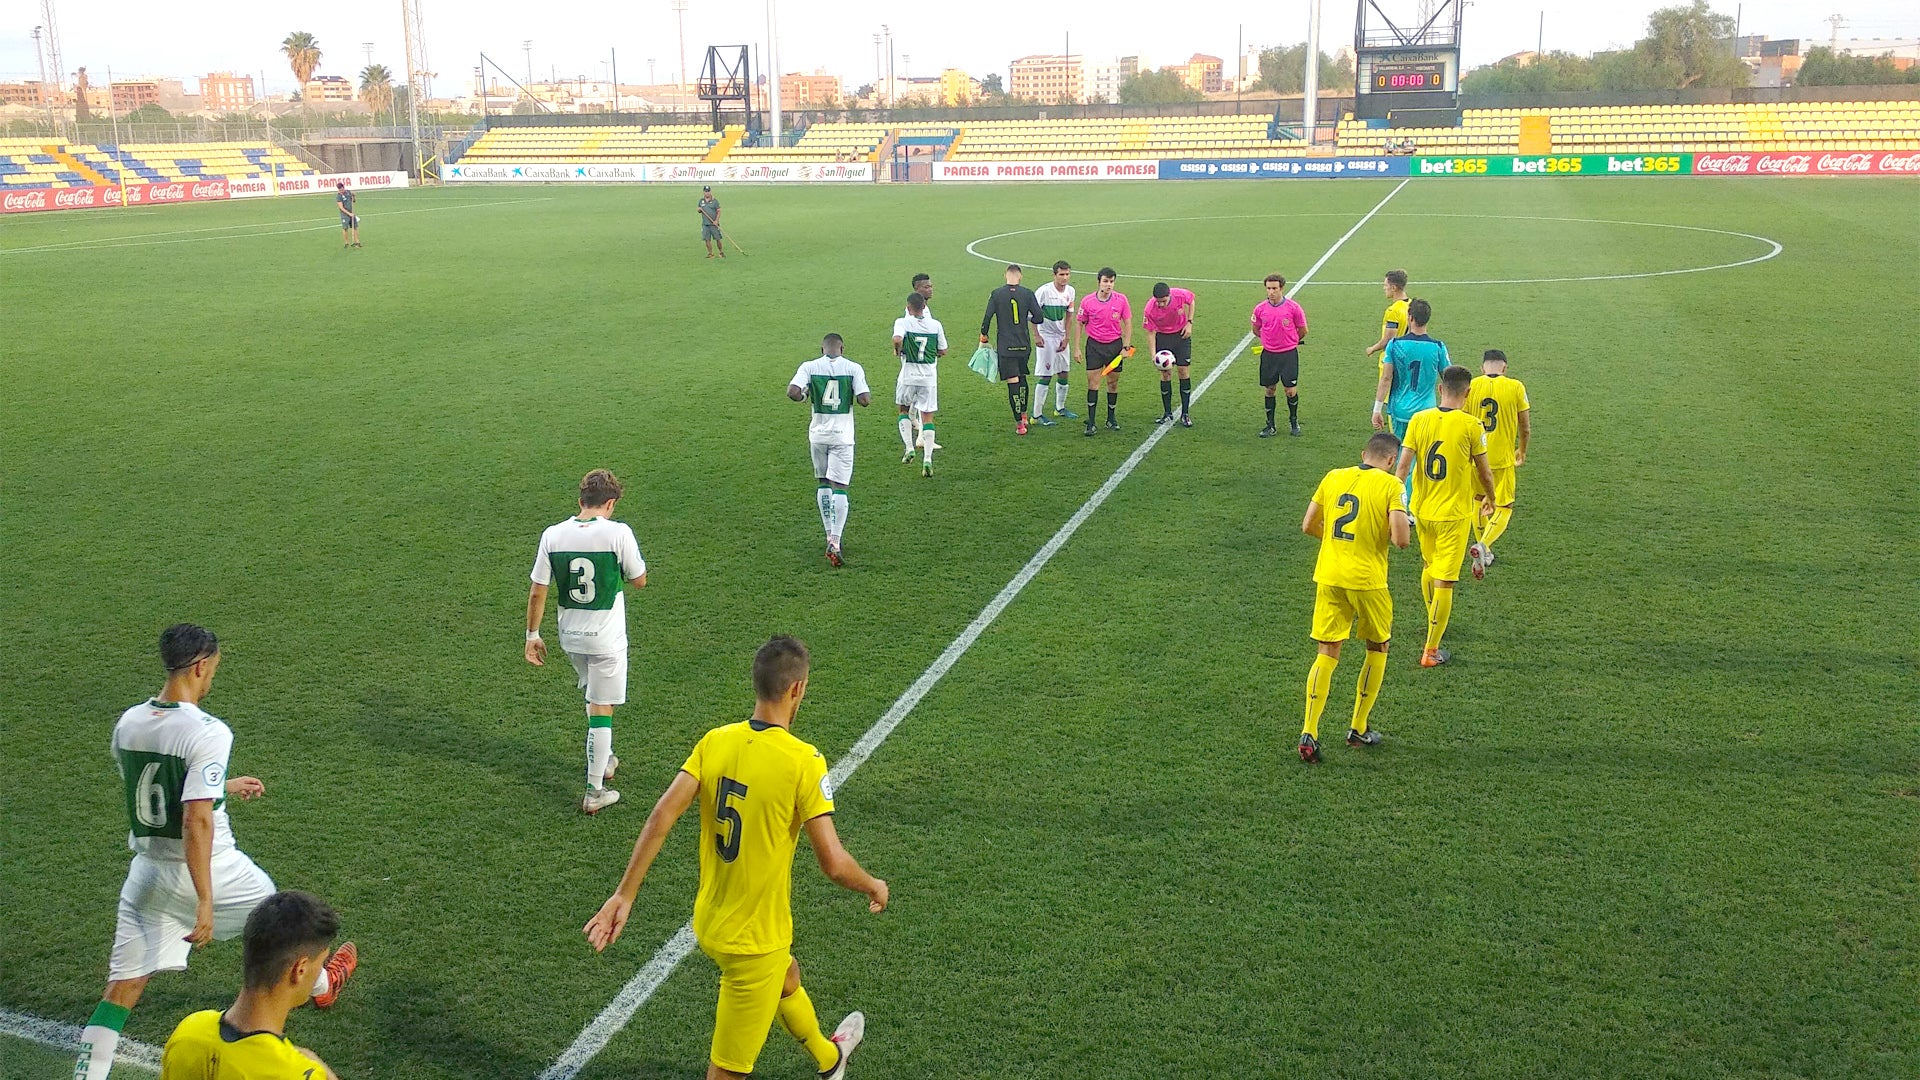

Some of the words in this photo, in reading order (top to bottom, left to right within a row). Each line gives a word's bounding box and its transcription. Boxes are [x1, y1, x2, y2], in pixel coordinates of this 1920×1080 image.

[1392, 53, 1439, 61] CaixaBank
[1378, 76, 1386, 87] 0
[1391, 74, 1424, 86] 00:00
[1432, 74, 1440, 85] 0
[463, 167, 508, 178] CaixaBank
[524, 167, 570, 178] CaixaBank
[588, 167, 636, 178] CaixaBank
[944, 166, 989, 176] PAMESA
[997, 166, 1044, 176] PAMESA
[1050, 165, 1098, 175] PAMESA
[1107, 164, 1156, 175] PAMESA
[1180, 163, 1206, 172] asisa
[1221, 163, 1247, 172] asisa
[1262, 162, 1290, 172] asisa
[1305, 162, 1332, 172] asisa
[1348, 161, 1376, 170] asisa
[1421, 159, 1488, 173] bet365
[1512, 158, 1582, 173] bet365
[1608, 157, 1680, 172] bet365
[230, 183, 266, 193] PAMESA
[359, 175, 391, 185] PAMESA
[1010, 299, 1020, 324] 1
[914, 336, 928, 361] 7
[1408, 360, 1421, 391] 1
[821, 379, 841, 410] 4
[1480, 397, 1498, 432] 3
[1424, 440, 1447, 481] 6
[1332, 493, 1360, 542] 2
[568, 557, 596, 604] 3
[135, 761, 167, 829] 6
[715, 775, 749, 863] 5
